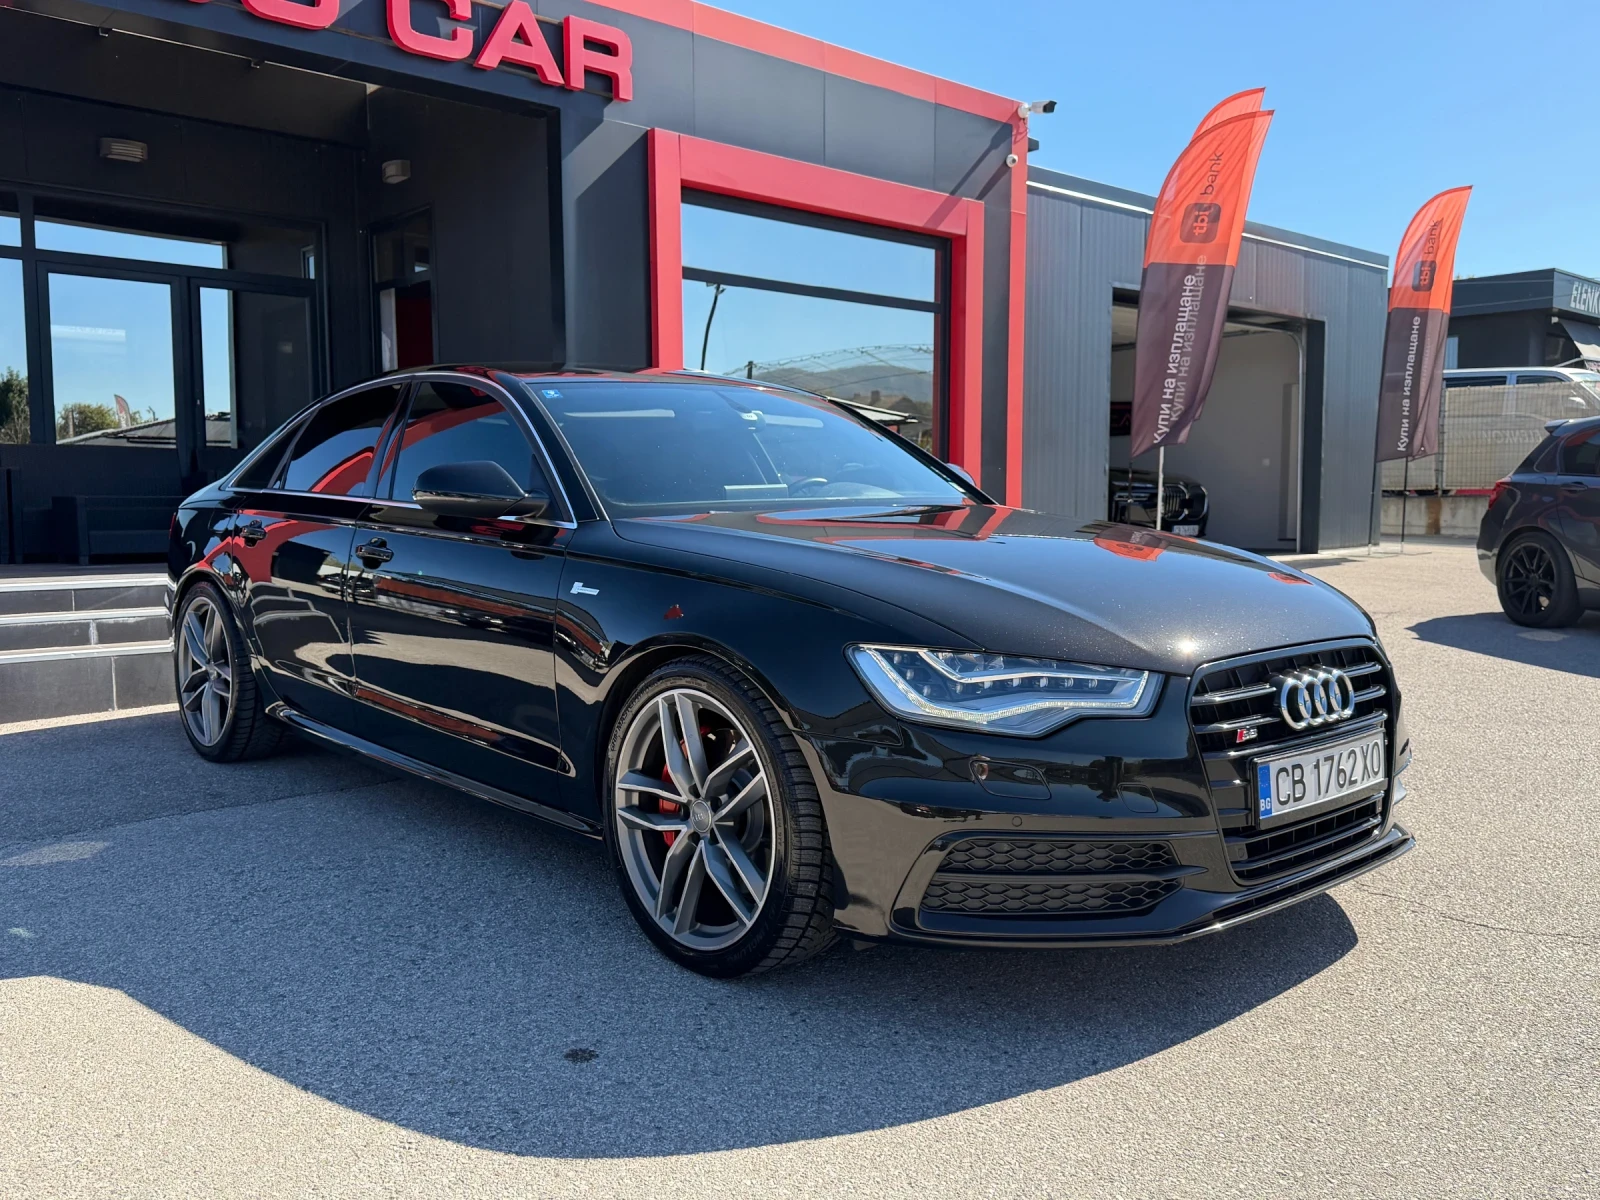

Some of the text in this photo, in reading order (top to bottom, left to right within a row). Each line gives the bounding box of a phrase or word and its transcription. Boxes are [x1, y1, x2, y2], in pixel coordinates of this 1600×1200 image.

[387, 0, 632, 101] CAR
[1200, 151, 1224, 195] bank
[1193, 211, 1211, 236] tbi
[1424, 220, 1438, 254] bank
[1570, 281, 1600, 314] ELENK
[1153, 275, 1195, 444] Купи на изплащане
[1397, 316, 1421, 451] Купи на изплащане
[1276, 763, 1306, 806] CB
[1314, 748, 1358, 797] 1762
[1260, 797, 1271, 811] BG
